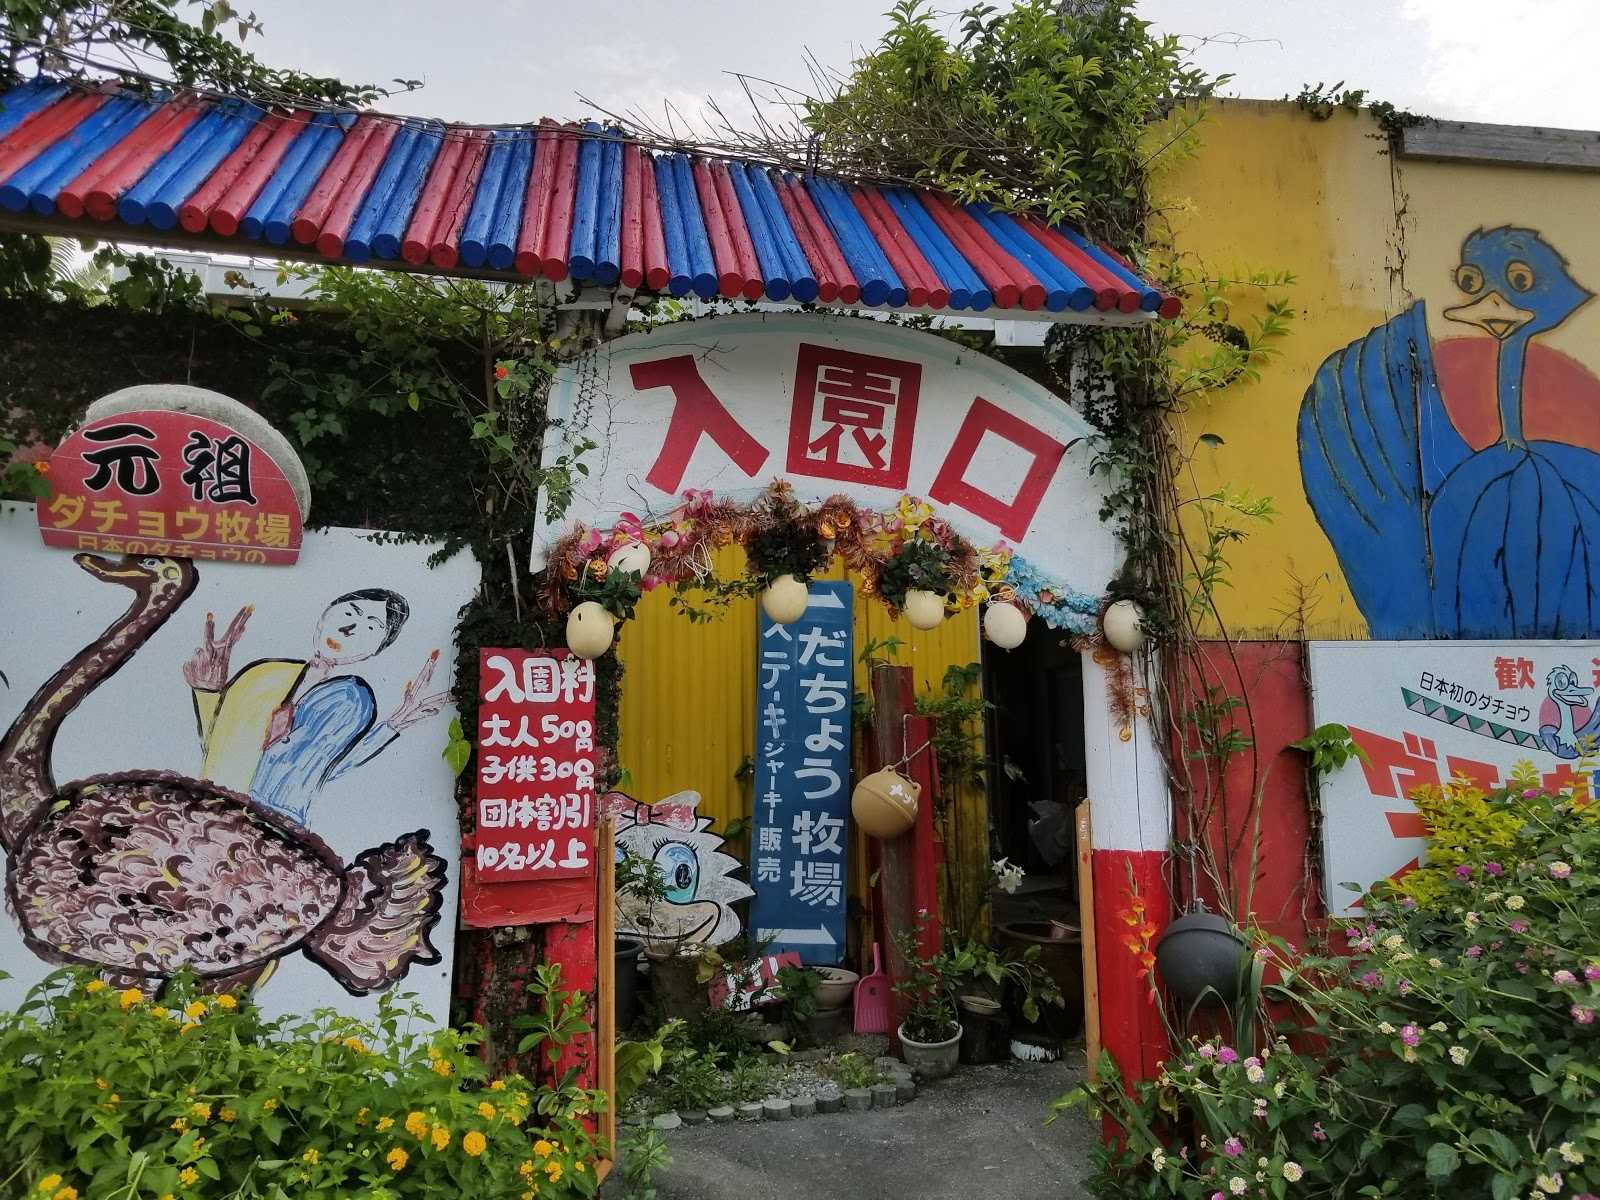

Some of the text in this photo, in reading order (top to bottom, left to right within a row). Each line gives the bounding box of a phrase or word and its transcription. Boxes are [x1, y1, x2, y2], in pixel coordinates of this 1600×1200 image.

[81, 424, 257, 505] 元祖
[628, 342, 1066, 544] 入園口
[48, 494, 293, 547] ダチョウ牧場
[484, 653, 597, 704] 入園料
[1420, 671, 1531, 723] 日本初のダチョウ
[789, 626, 849, 907] だちょう牧場
[479, 793, 590, 832] 団体割引
[477, 838, 590, 872] 10名以上
